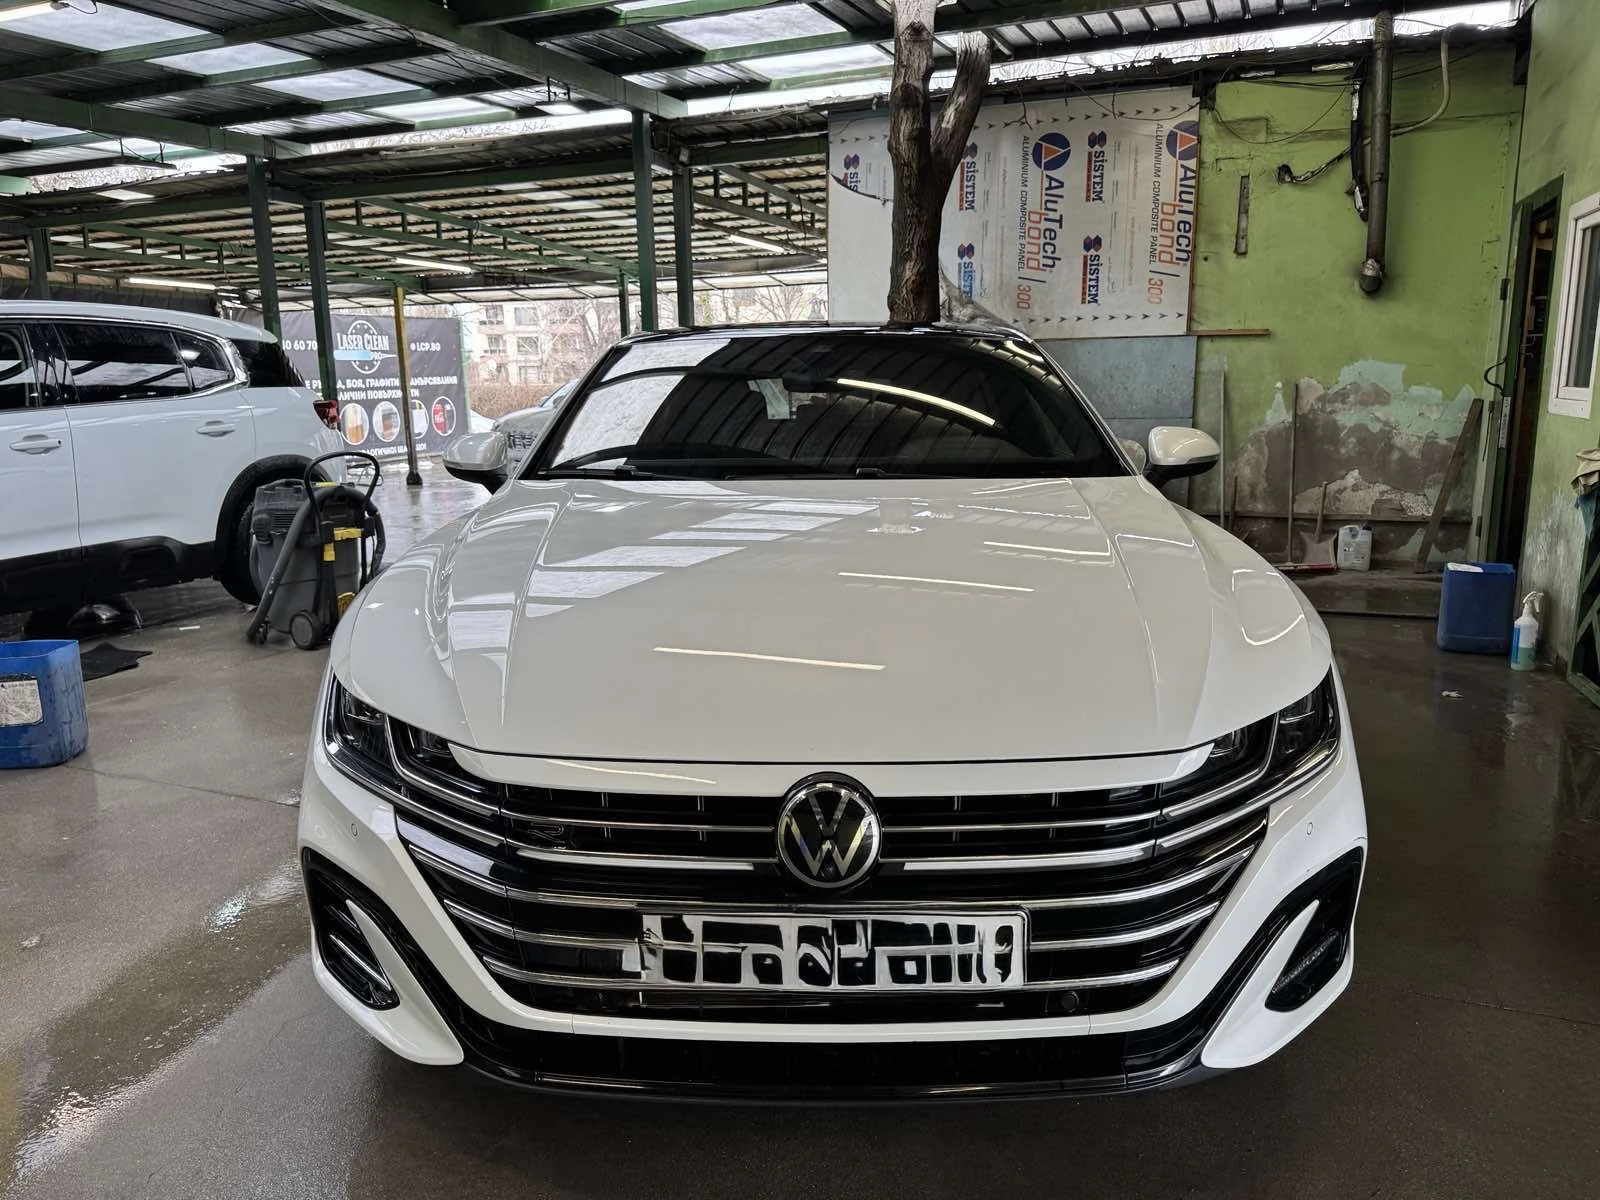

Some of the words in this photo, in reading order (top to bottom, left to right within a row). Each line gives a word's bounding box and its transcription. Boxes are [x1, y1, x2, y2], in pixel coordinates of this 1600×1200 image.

[1021, 135, 1030, 188] ALUMINIUM
[1152, 123, 1163, 178] ALUMINIUM
[1019, 190, 1028, 240] COMPOSITE
[1042, 174, 1065, 269] AluTech
[1150, 180, 1161, 233] COMPOSITE
[1017, 242, 1026, 271] PANEL
[1026, 210, 1048, 272] bond
[1148, 235, 1158, 265] PANEL
[1158, 202, 1183, 266] bond
[1017, 284, 1032, 310] 300
[1147, 278, 1163, 304] 300
[293, 340, 305, 350] 60
[306, 340, 318, 350] 70
